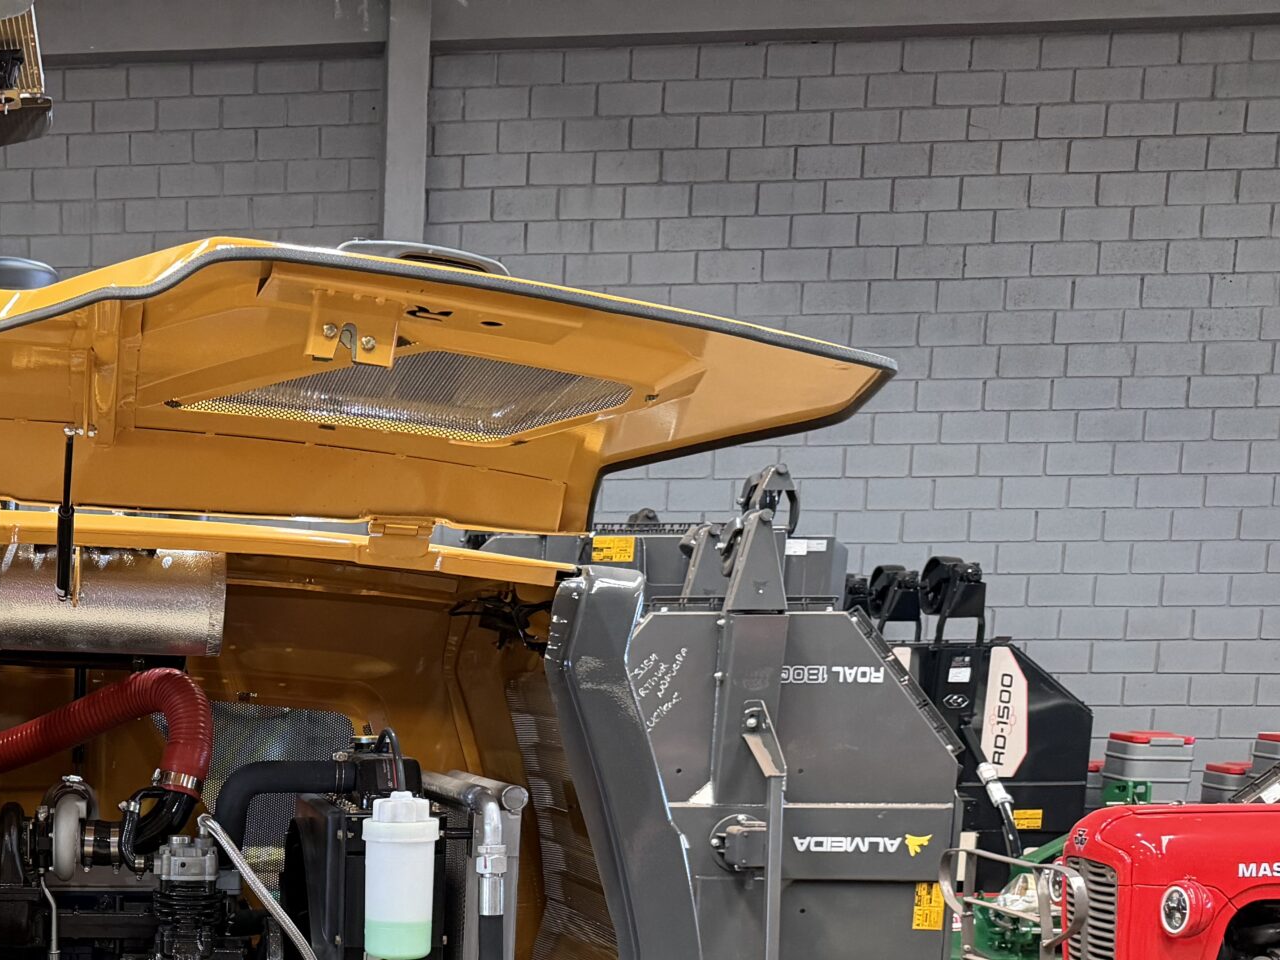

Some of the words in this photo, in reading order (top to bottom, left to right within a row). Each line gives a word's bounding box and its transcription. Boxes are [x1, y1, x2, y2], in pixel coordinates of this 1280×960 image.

[831, 665, 885, 684] ROAL
[992, 673, 1014, 766] RD-1500
[792, 836, 903, 853] ALMEIDA
